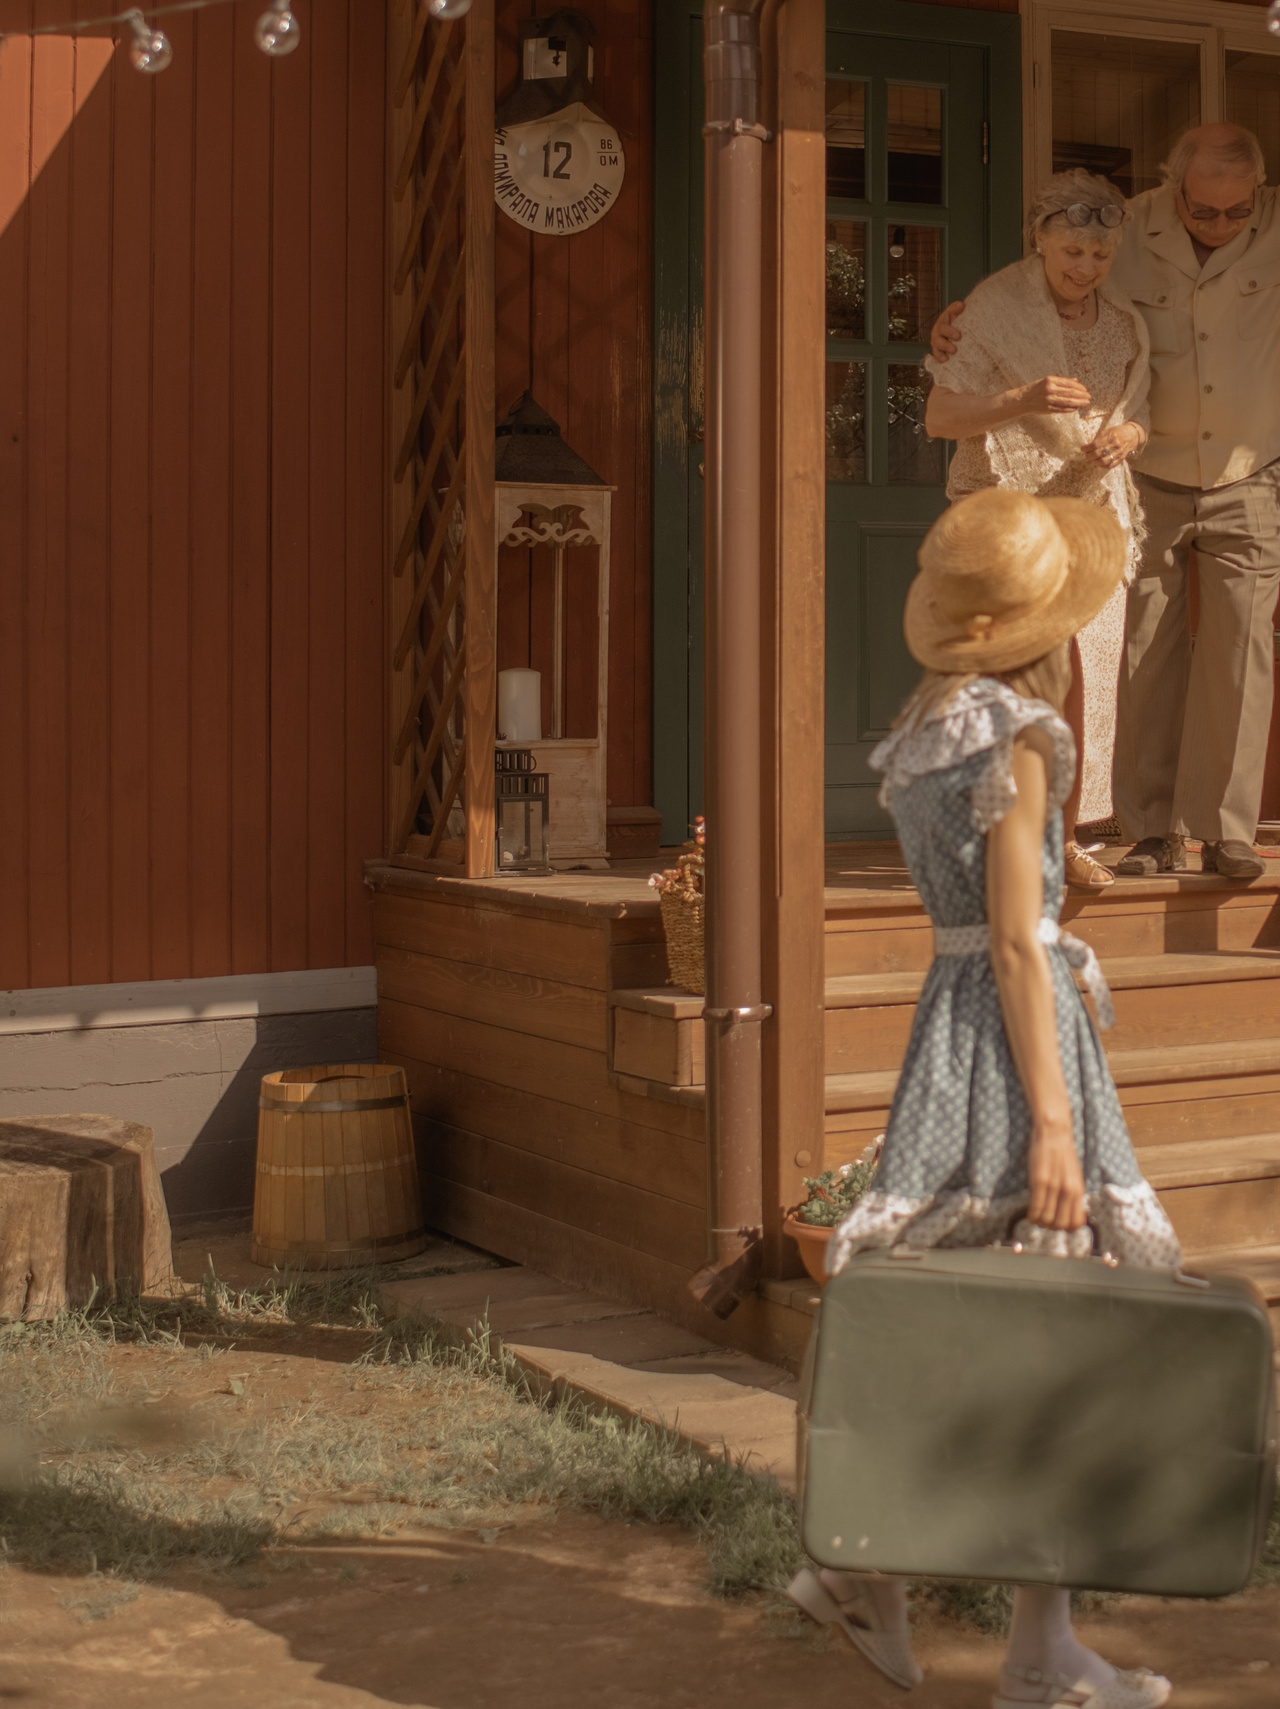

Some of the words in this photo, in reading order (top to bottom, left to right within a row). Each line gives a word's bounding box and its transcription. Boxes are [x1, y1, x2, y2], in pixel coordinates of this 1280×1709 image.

[542, 141, 572, 180] 12
[600, 138, 613, 150] 86
[545, 182, 612, 229] МАКАРОВА
